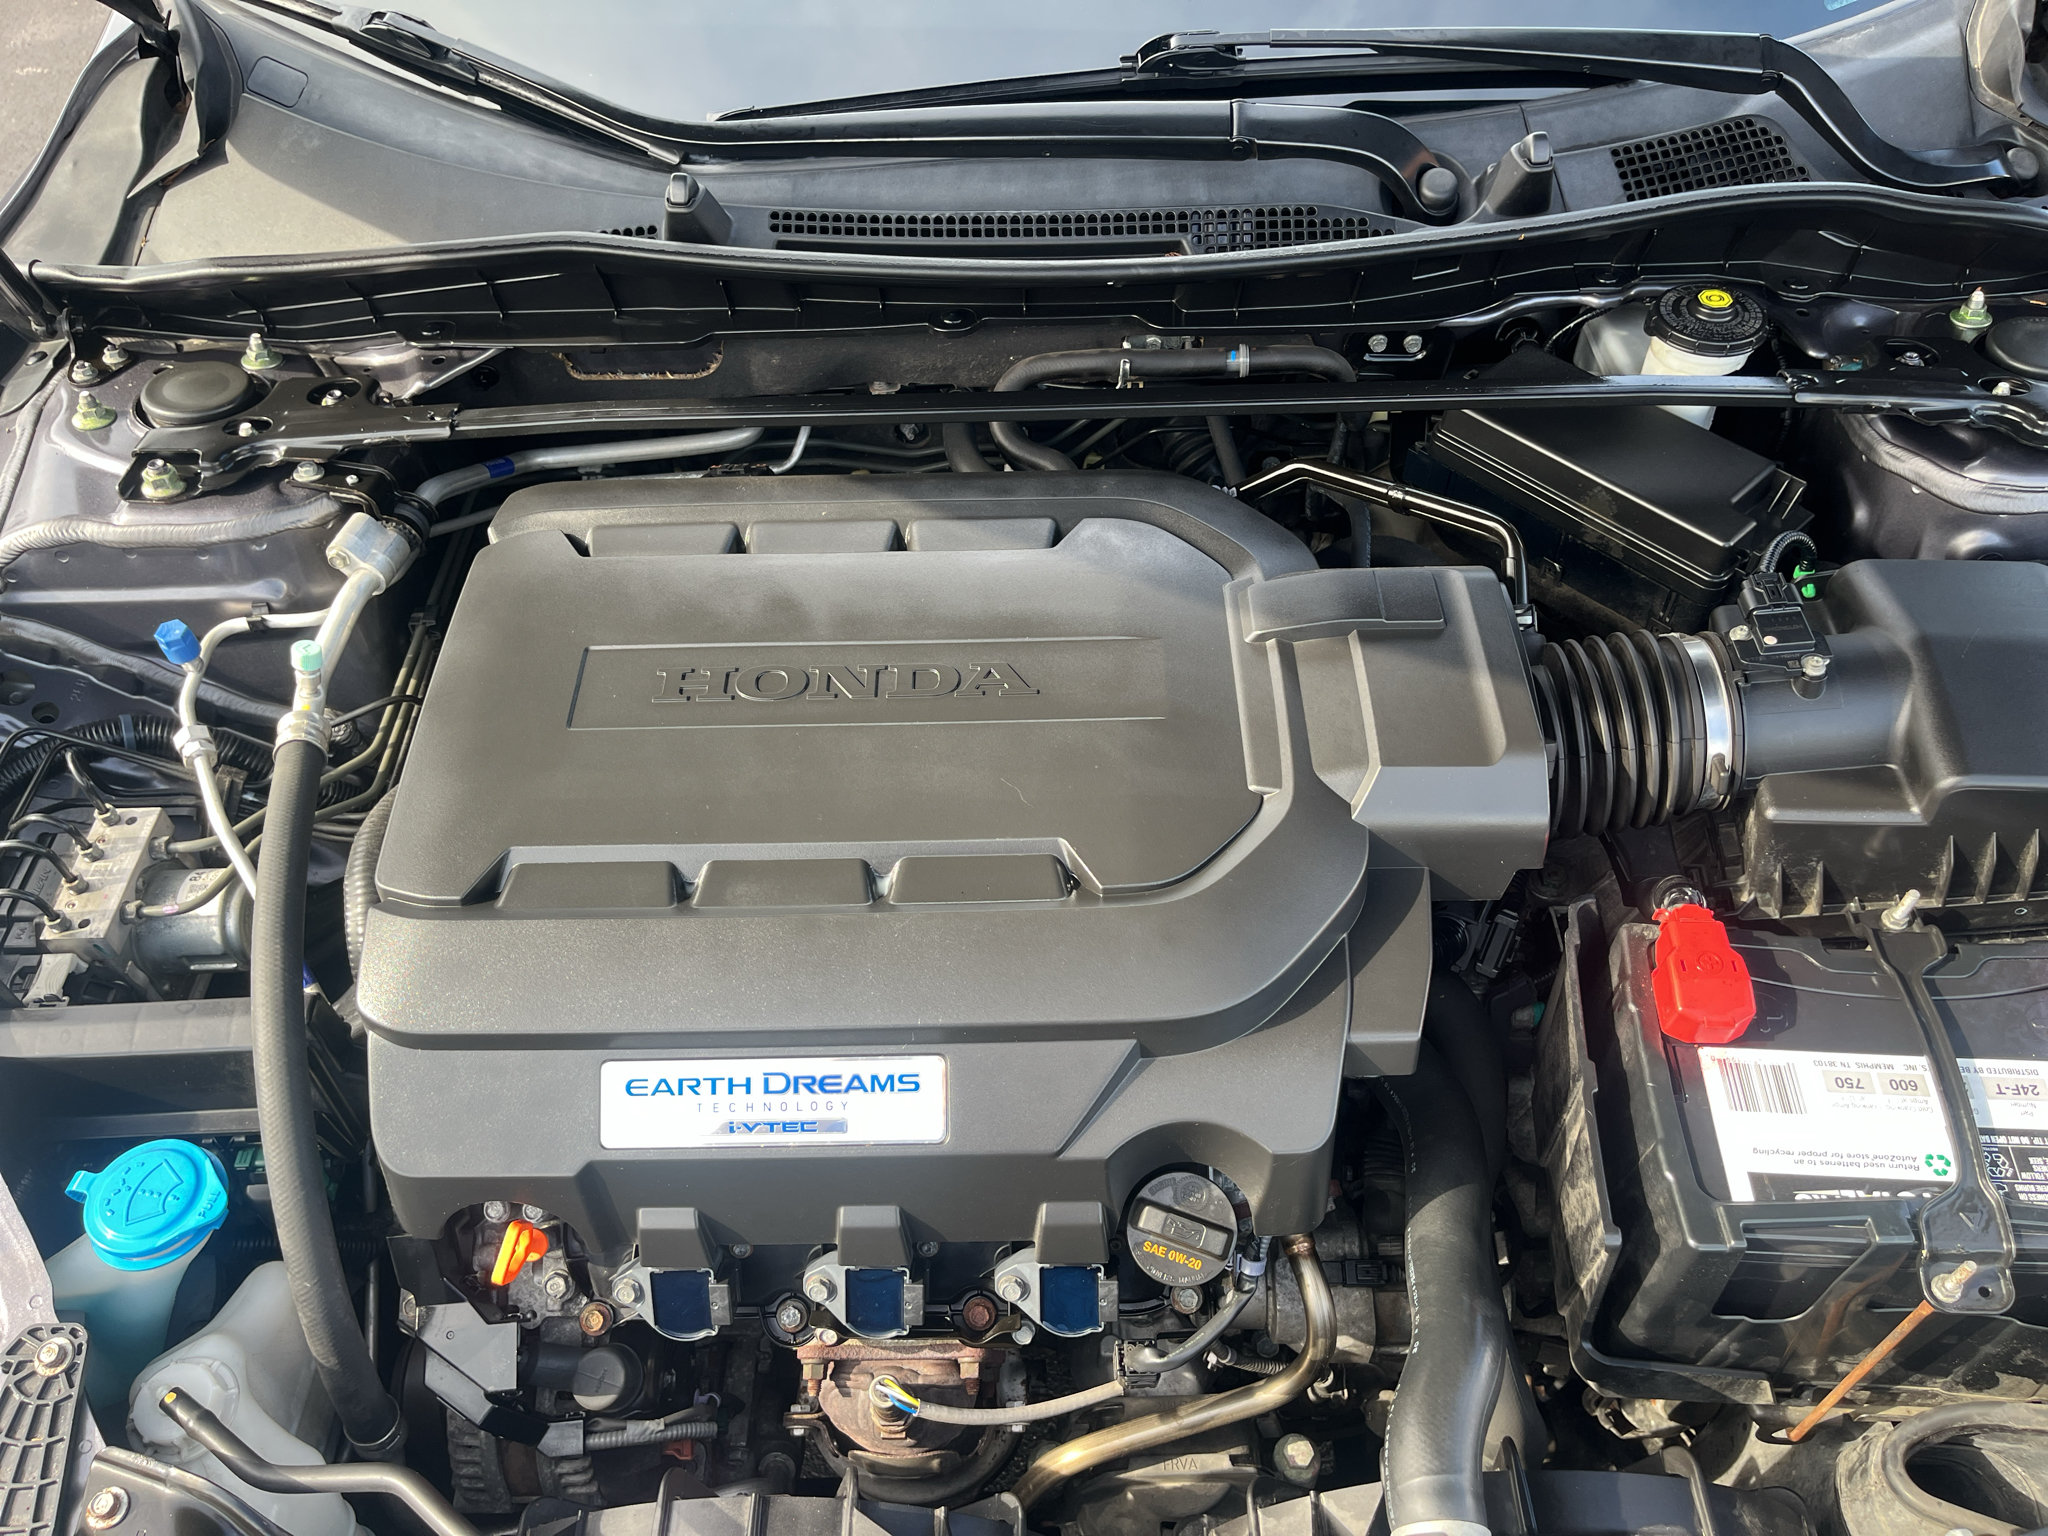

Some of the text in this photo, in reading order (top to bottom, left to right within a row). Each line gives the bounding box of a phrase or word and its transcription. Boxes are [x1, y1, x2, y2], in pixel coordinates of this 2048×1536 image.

[652, 662, 1040, 703] HONDA
[1986, 1067, 2039, 1076] DISTRIBUTED
[625, 1071, 921, 1097] EARTH DREAMS
[1834, 1076, 1865, 1090] 750
[1888, 1078, 1919, 1092] 600
[1996, 1083, 2040, 1097] 24F-T
[697, 1101, 849, 1114] TECHNOLOGY
[728, 1121, 819, 1134] i-VTEC
[1752, 1147, 1795, 1157] recycling
[1797, 1150, 1828, 1158] proper
[1831, 1152, 1844, 1160] for
[1846, 1153, 1870, 1161] store
[1793, 1158, 1920, 1172] Return used batteries to an
[197, 1190, 221, 1219] PULL
[1143, 1240, 1168, 1258] SAE
[1168, 1249, 1203, 1271] 0W-20
